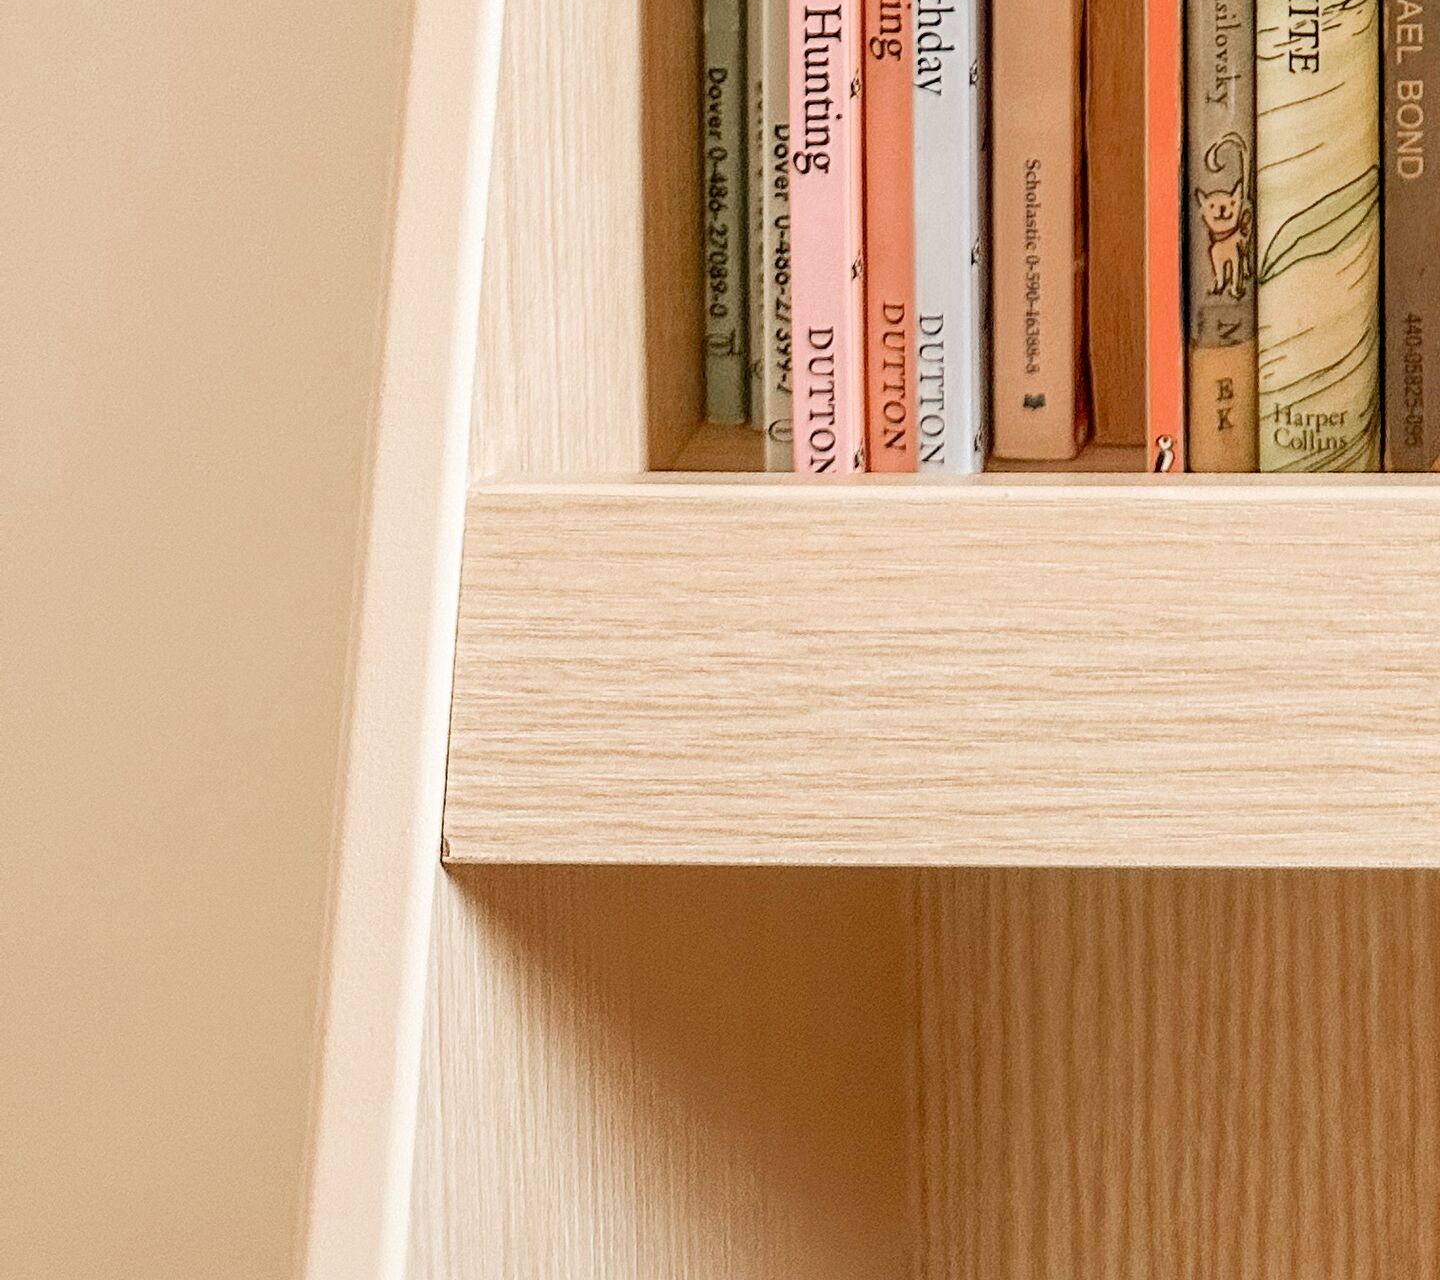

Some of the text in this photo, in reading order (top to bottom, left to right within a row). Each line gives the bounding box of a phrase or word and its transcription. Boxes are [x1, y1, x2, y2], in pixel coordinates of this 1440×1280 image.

[706, 66, 728, 142] Dover
[793, 4, 843, 175] Hunting
[1396, 79, 1424, 180] BOND
[1025, 159, 1042, 250] Scholastic
[808, 326, 836, 472] DUTTON
[882, 303, 907, 451] DUTTON
[918, 314, 945, 464] DUTTON
[1273, 402, 1348, 433] Harper
[1273, 427, 1347, 451] Collins
